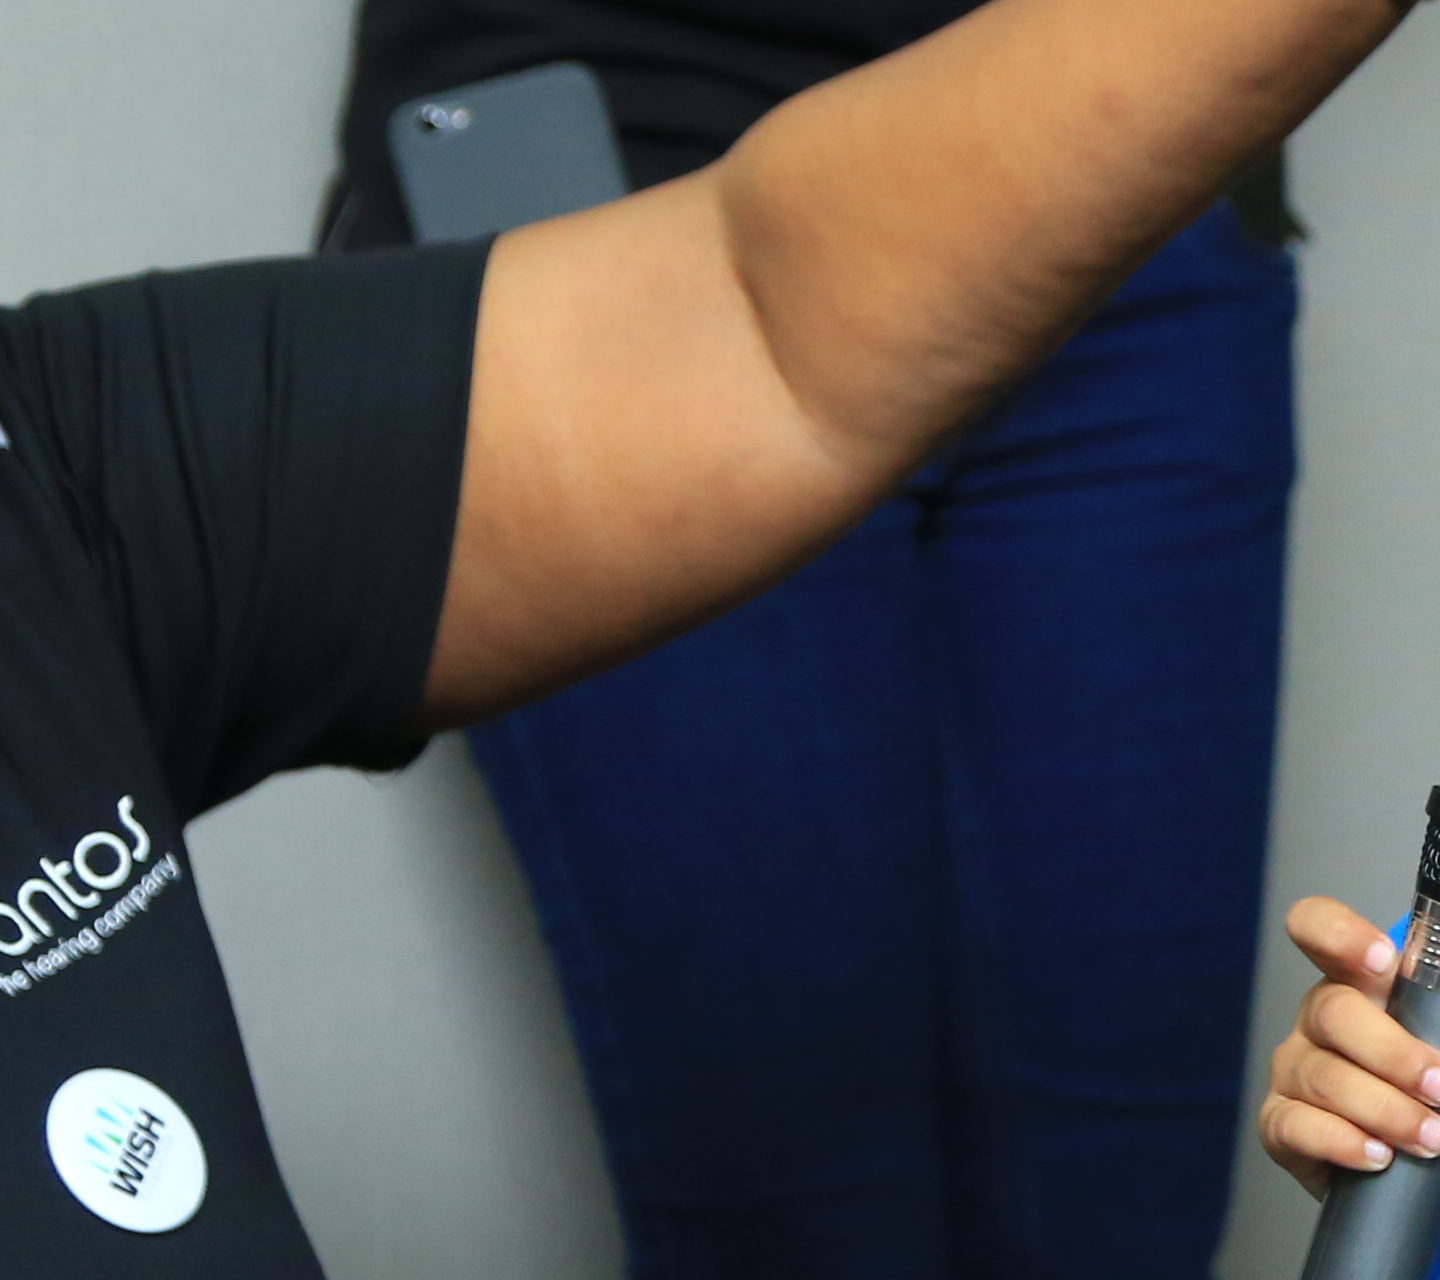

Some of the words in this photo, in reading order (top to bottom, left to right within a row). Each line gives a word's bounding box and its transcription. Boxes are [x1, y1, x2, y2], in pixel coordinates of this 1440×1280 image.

[22, 926, 104, 983] hearing
[94, 851, 183, 938] company
[109, 1106, 166, 1199] WISH
